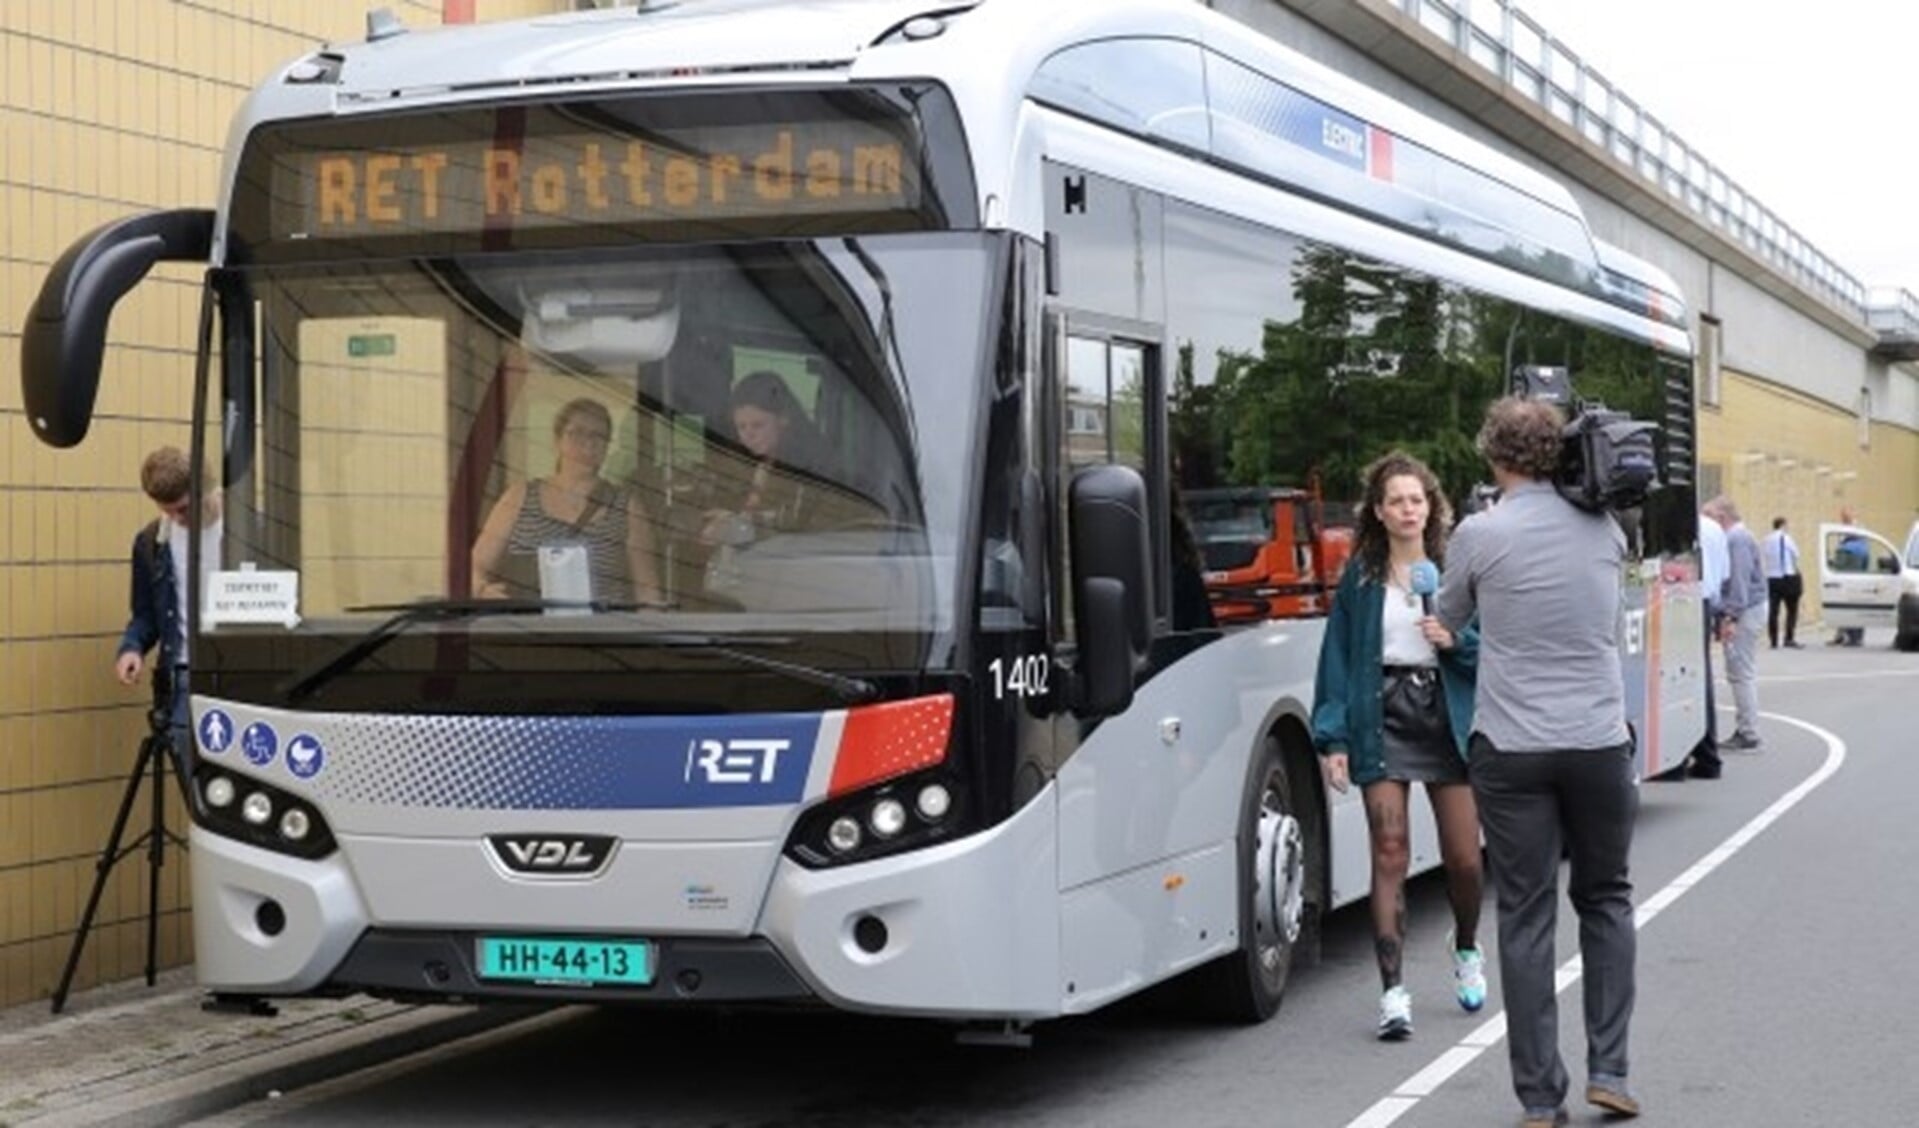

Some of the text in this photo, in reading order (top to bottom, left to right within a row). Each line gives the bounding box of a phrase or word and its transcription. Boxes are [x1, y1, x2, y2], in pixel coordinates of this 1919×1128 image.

[319, 131, 900, 224] RET Rotterdam
[988, 653, 1050, 700] 1402
[697, 738, 791, 784] RET
[505, 840, 594, 866] VDL
[499, 943, 630, 977] HH-44-13
